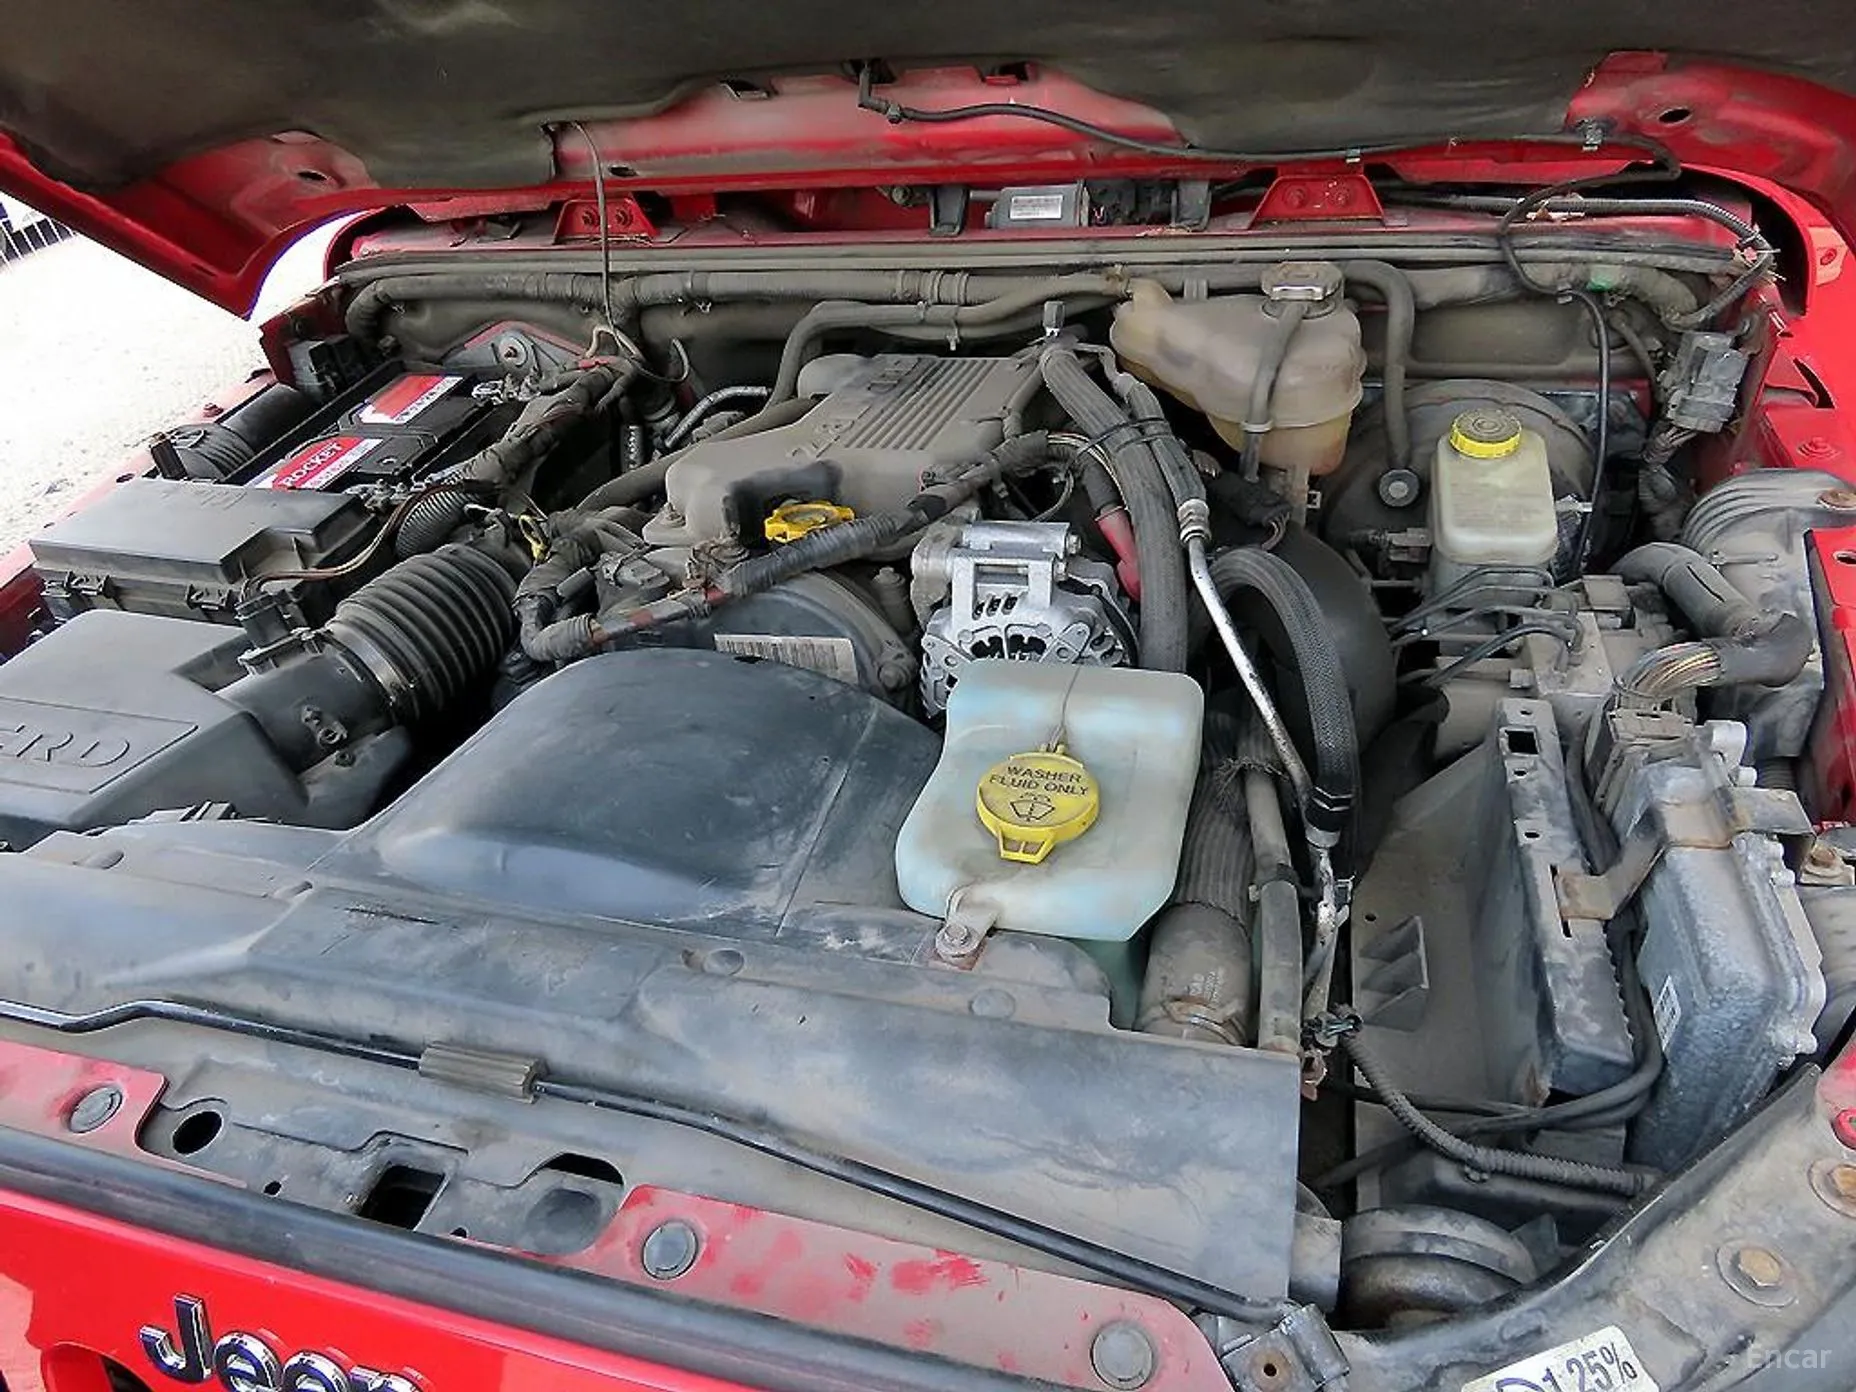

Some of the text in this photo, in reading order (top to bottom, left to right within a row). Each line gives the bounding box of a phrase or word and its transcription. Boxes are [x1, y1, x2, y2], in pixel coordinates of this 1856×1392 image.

[282, 442, 343, 487] ROCKET
[989, 773, 1089, 796] FLUID ONLY
[1006, 766, 1082, 783] WASHER
[139, 1292, 430, 1392] Jee
